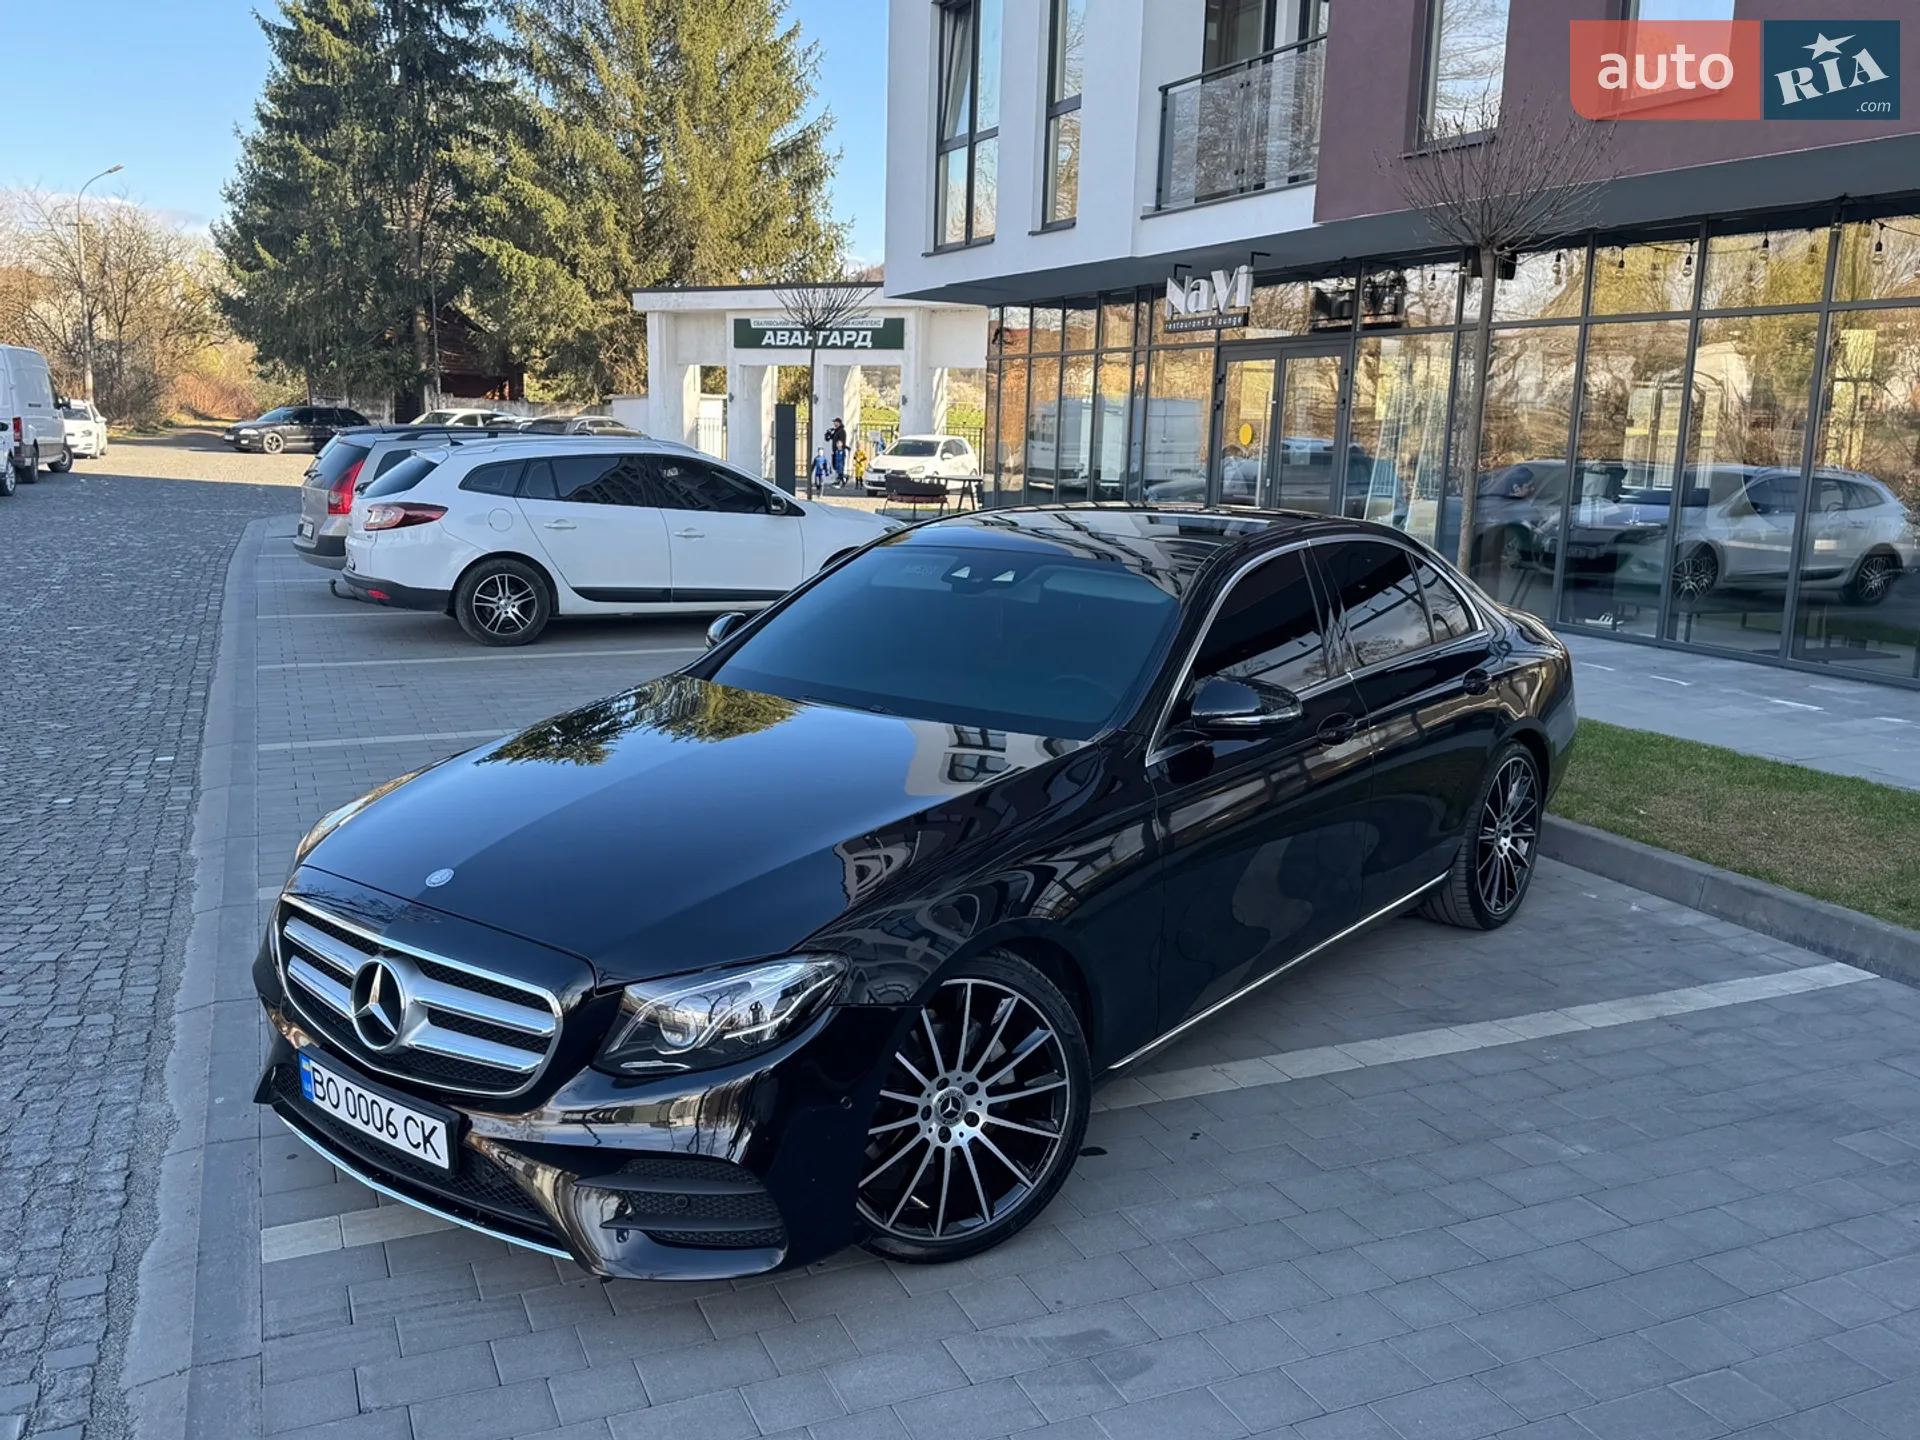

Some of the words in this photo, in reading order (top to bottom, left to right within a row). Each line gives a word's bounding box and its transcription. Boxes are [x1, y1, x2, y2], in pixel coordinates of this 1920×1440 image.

[1165, 264, 1254, 321] NaVi
[761, 330, 873, 348] АВАНГАРД
[1165, 319, 1205, 331] restaurant
[1214, 315, 1243, 327] lounge
[312, 1066, 340, 1109] BO
[344, 1086, 399, 1140] 0006
[404, 1115, 442, 1160] CK
